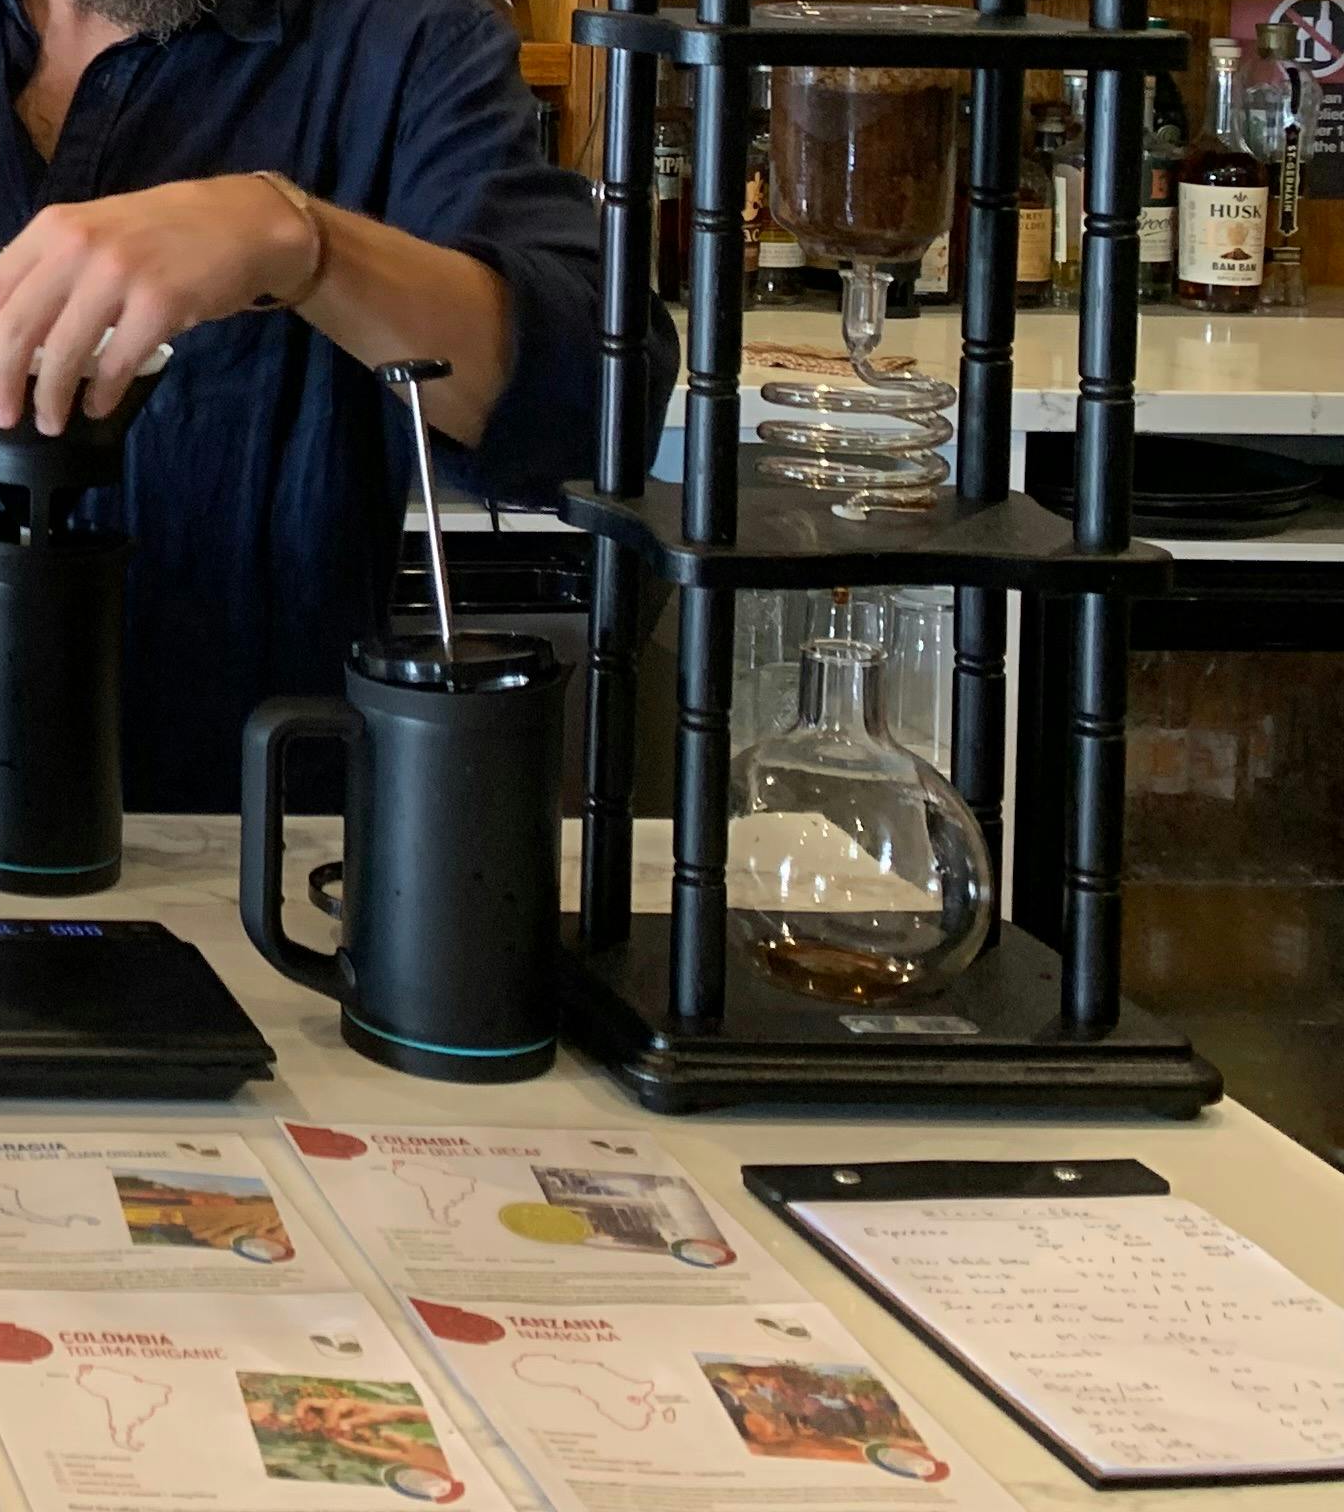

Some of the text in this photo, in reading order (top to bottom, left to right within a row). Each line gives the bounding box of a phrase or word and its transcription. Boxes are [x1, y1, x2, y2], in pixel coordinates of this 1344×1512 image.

[1210, 203, 1263, 219] HUSK
[506, 1315, 614, 1330] TANZANIA
[58, 1331, 174, 1346] COLOMBIA
[65, 1345, 137, 1358] TOLIMA
